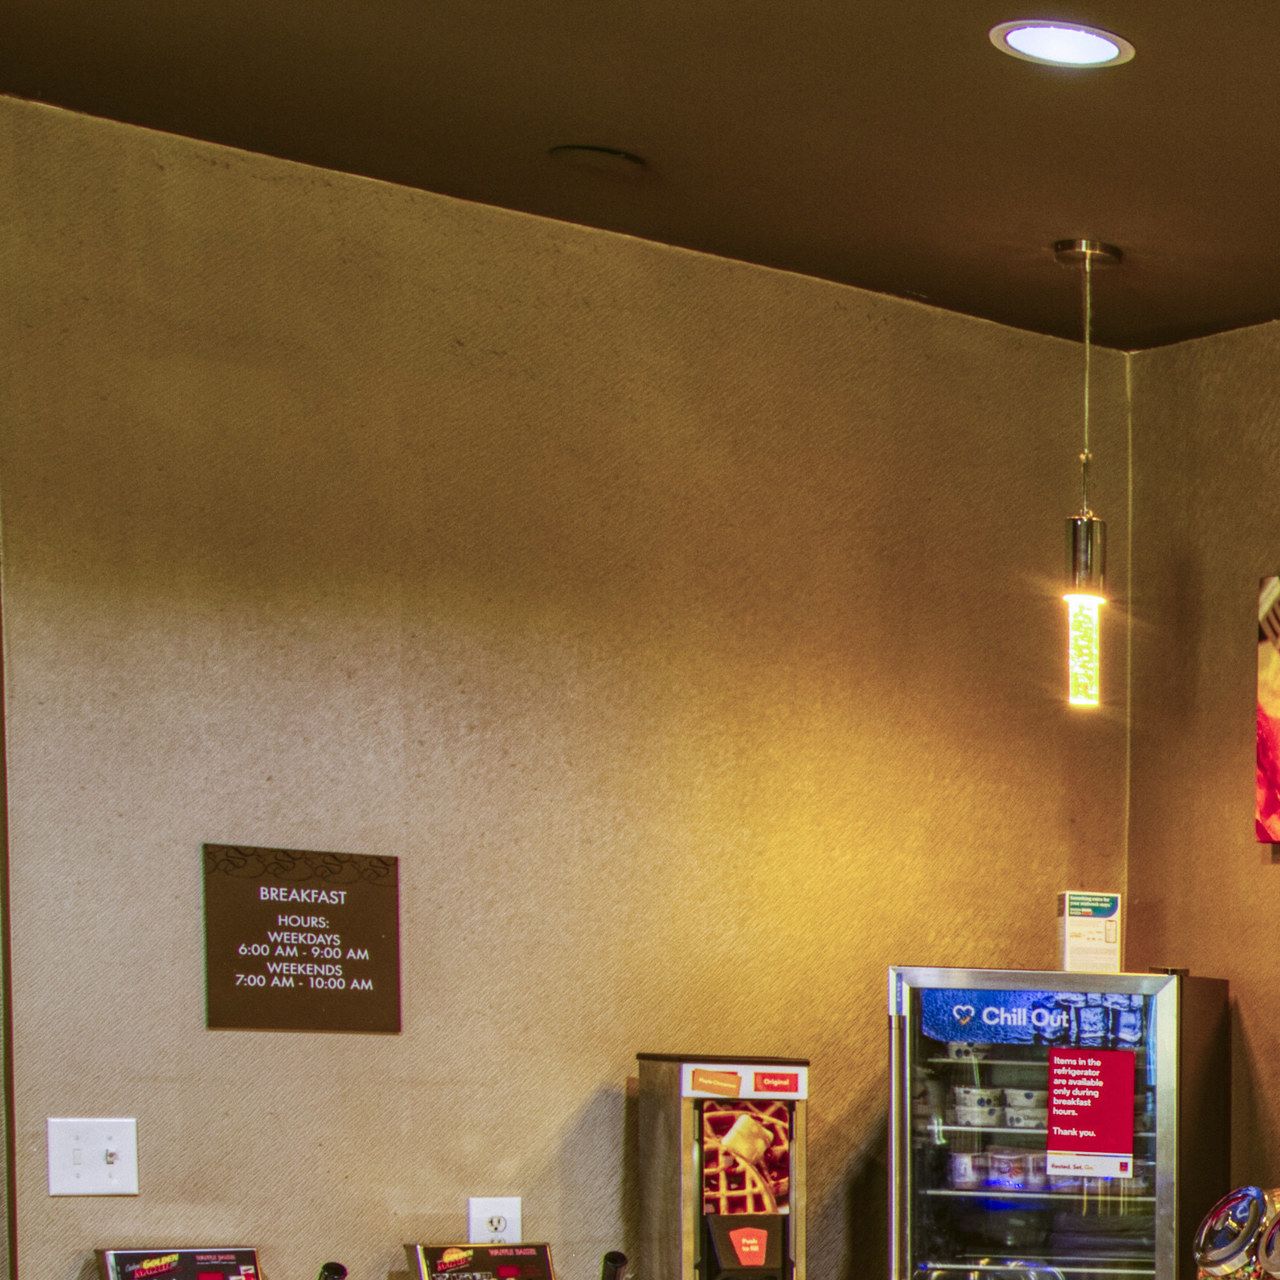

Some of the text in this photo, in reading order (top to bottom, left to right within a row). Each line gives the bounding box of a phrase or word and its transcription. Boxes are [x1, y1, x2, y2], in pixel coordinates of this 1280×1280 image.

[259, 886, 347, 904] BREAKFAST
[278, 915, 330, 929] HOURS:
[268, 931, 340, 946] WEEKDAYS
[238, 943, 270, 956] 6:00
[274, 946, 299, 957] AM
[311, 946, 342, 960] 9:00
[346, 949, 370, 960] AM
[267, 962, 343, 976] WEEKENDS
[235, 974, 266, 987] 7:00
[270, 976, 295, 988] AM
[308, 977, 346, 990] 10:00
[350, 979, 373, 990] AM
[982, 1006, 1069, 1027] Chill Out
[1054, 1056, 1102, 1067] Items in the
[1053, 1067, 1100, 1077] refrigerator
[763, 1078, 790, 1087] Original
[1068, 1078, 1103, 1087] available
[1053, 1087, 1100, 1098] only during
[1052, 1097, 1091, 1107] breakfast
[1052, 1107, 1078, 1116] hours.
[1052, 1126, 1096, 1138] Thank you.
[142, 1253, 180, 1269] GOLDEN
